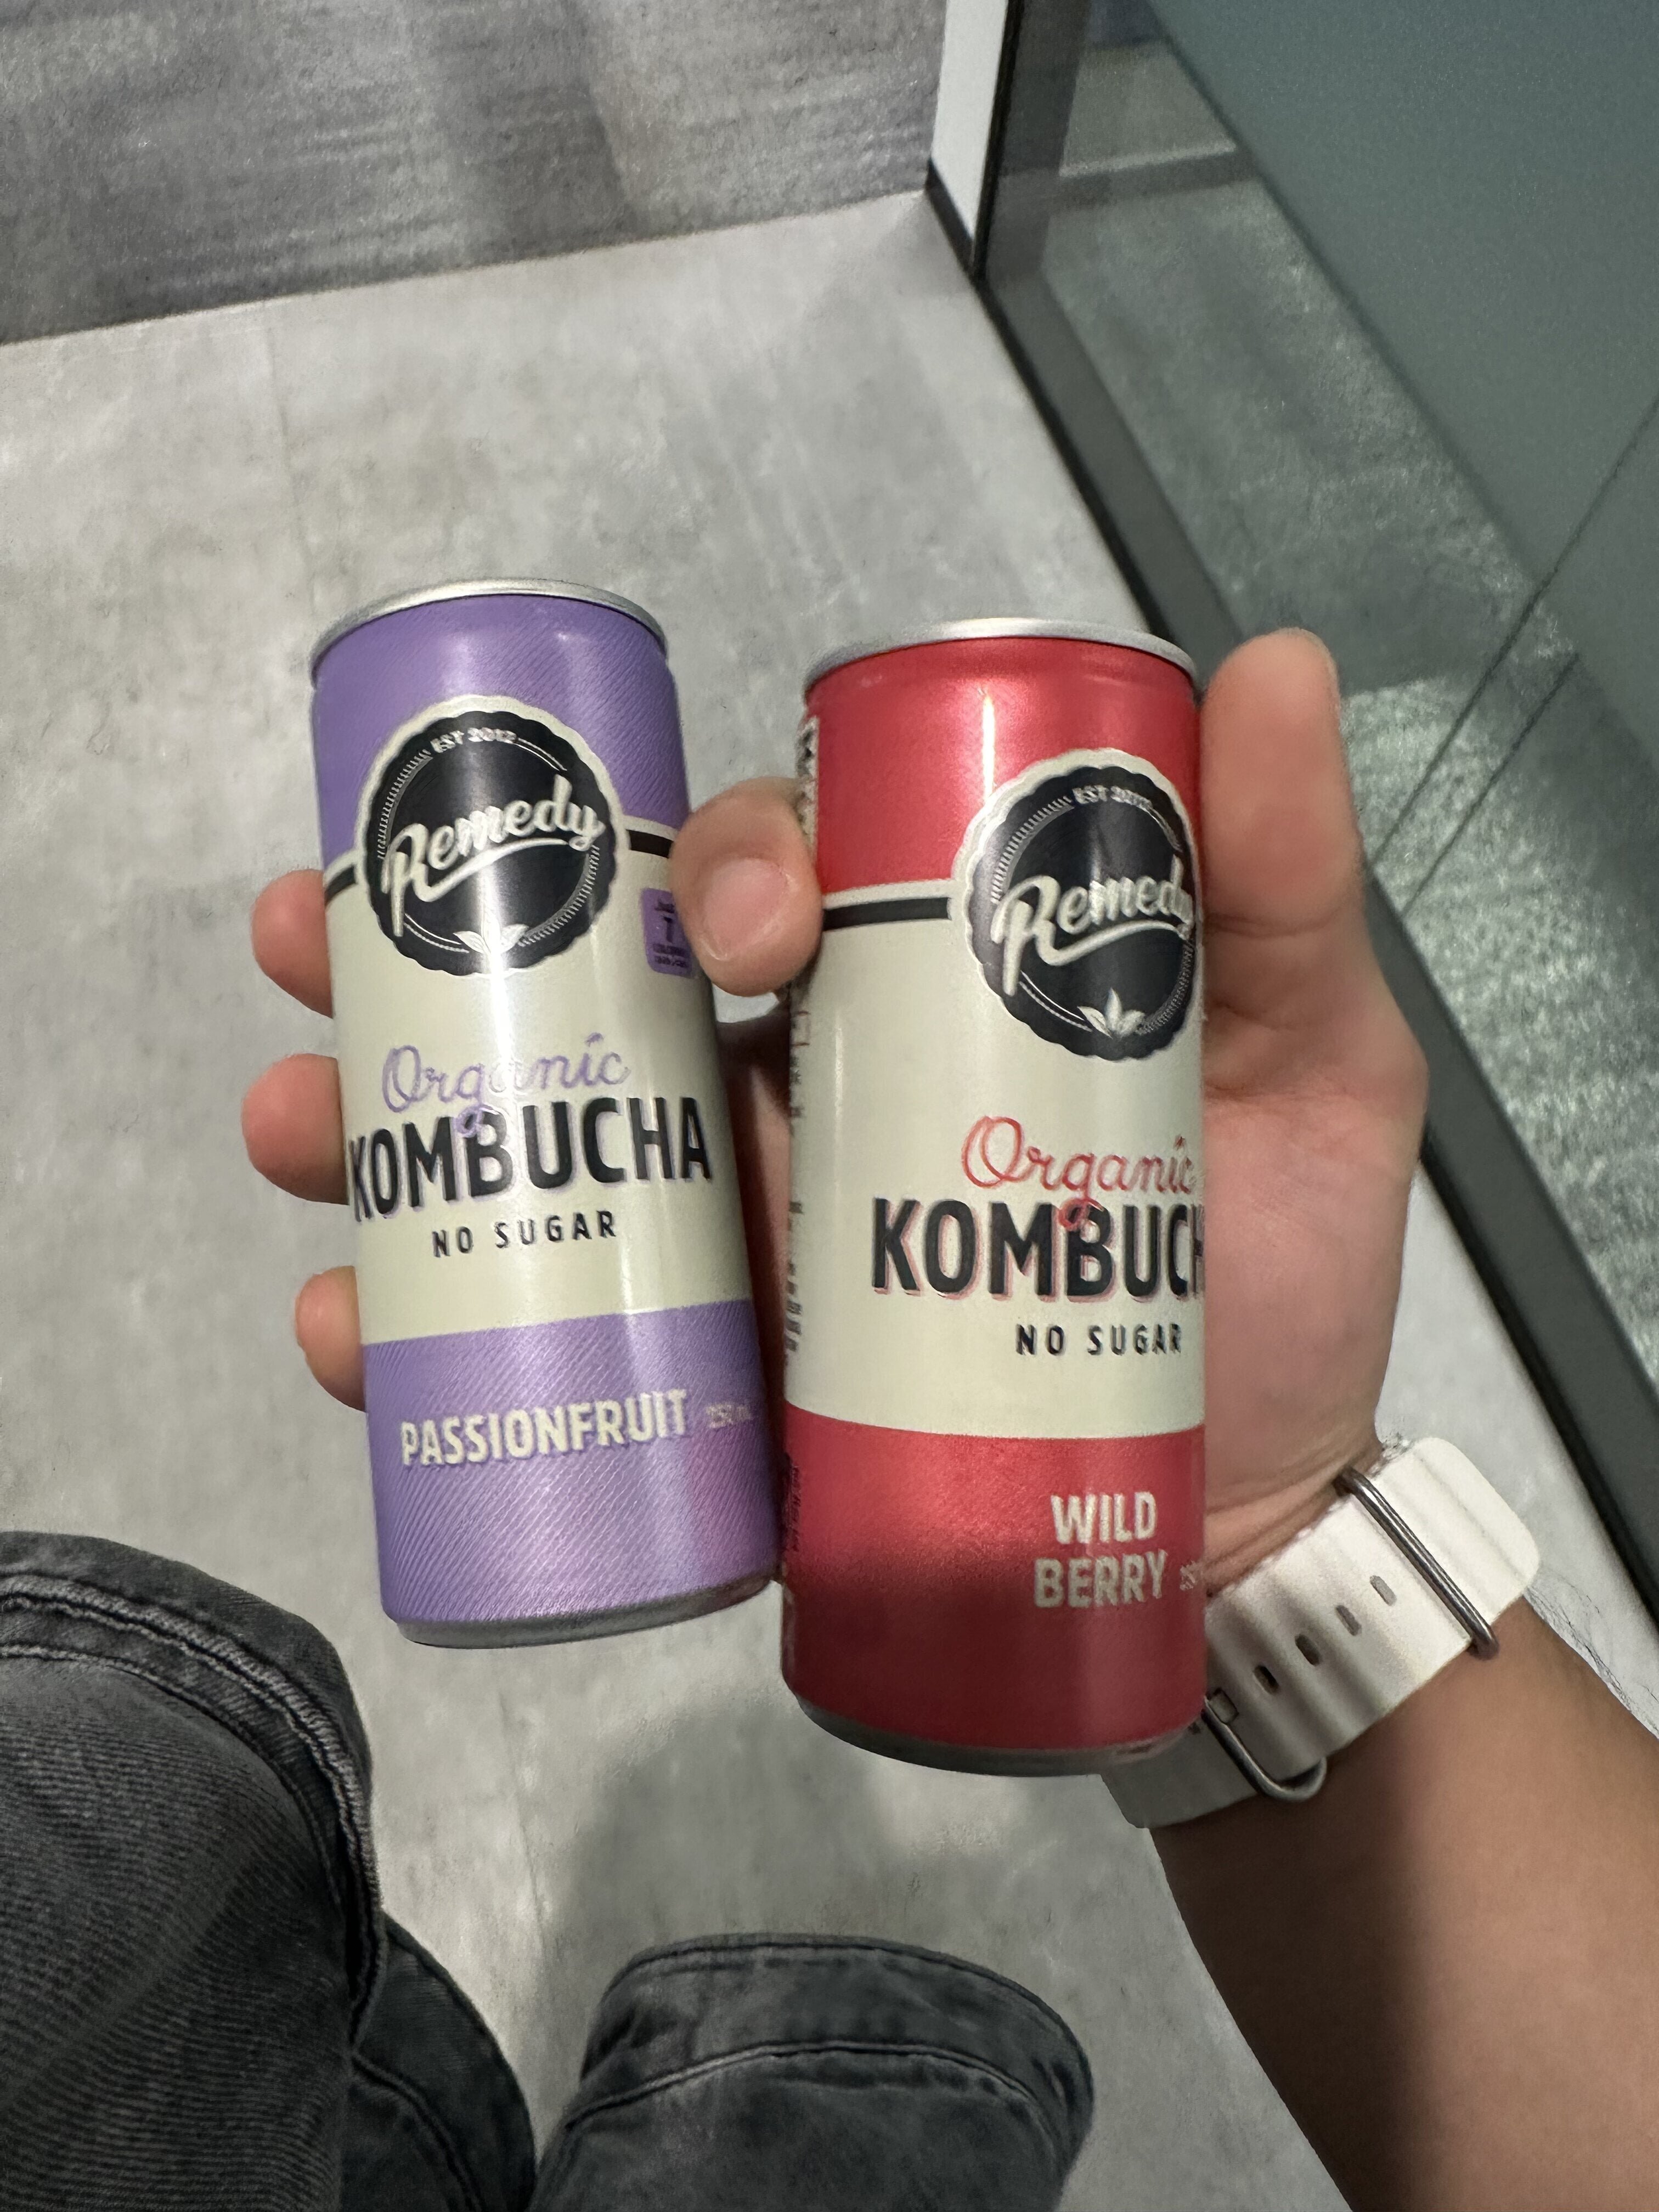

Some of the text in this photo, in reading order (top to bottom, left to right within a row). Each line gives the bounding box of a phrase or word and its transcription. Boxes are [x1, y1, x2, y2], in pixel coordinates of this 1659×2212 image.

[381, 774, 605, 937] Remedy
[382, 1032, 631, 1136] Organic
[348, 1097, 712, 1223] KOMBUCHA
[961, 1115, 1195, 1230] Organic
[432, 1210, 616, 1258] NO SUGAR
[1016, 1323, 1182, 1356] NO SUGAR
[400, 1389, 687, 1466] PASSIONFRUIT
[1051, 1491, 1158, 1544] WILD
[1034, 1549, 1167, 1609] BERRY
